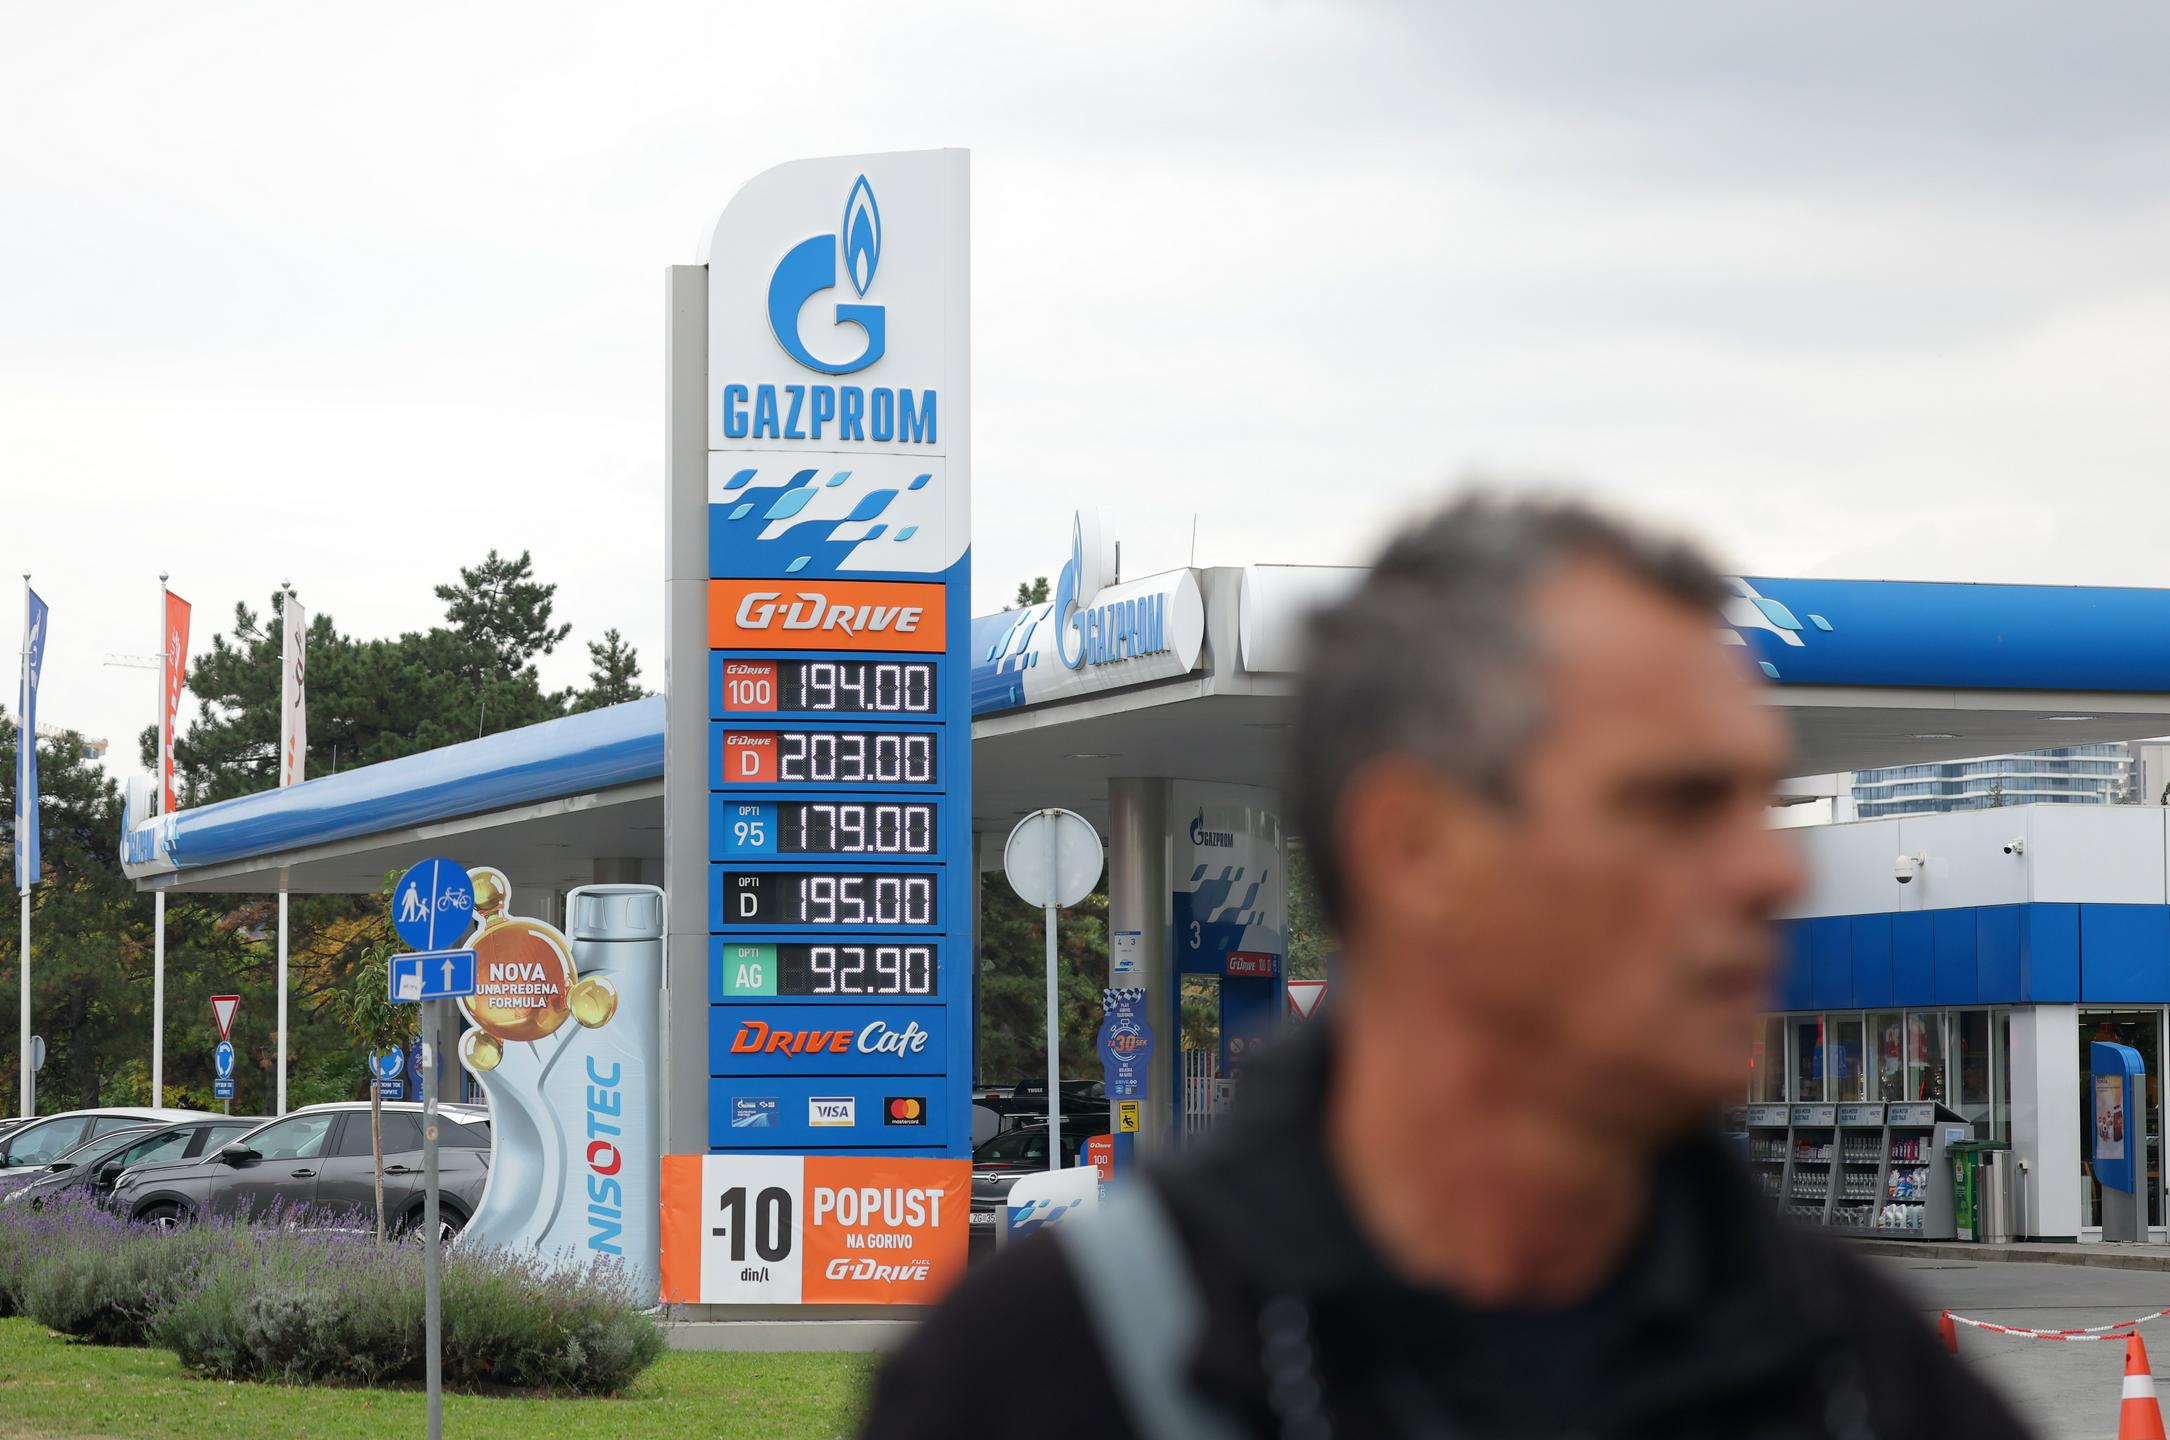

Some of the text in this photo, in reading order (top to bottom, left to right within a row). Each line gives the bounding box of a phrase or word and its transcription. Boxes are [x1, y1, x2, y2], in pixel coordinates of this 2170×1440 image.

[723, 383, 937, 444] GAZPROM
[1086, 592, 1164, 666] GAZPROM
[728, 680, 770, 705] 100
[800, 664, 930, 711] 194.00
[741, 750, 760, 776] D
[781, 734, 930, 781] 203.00
[739, 806, 760, 816] OPTI
[734, 821, 764, 847] 95
[800, 805, 930, 852] 179.00
[1204, 831, 1234, 849] GAZPROM
[738, 877, 759, 887] OPTI
[740, 893, 758, 917] D
[800, 877, 930, 924] 195.00
[1190, 920, 1201, 950] 3
[738, 948, 759, 958] OPTI
[489, 963, 546, 981] NOVA
[735, 964, 762, 988] AG
[810, 947, 930, 993] 92.90
[476, 983, 559, 995] UNAPREĐENA
[489, 997, 547, 1008] FORMULA
[730, 1020, 929, 1058] DRIVE Cafe
[1115, 1034, 1136, 1053] 30
[816, 1105, 849, 1118] VISA
[586, 1055, 622, 1255] NISOTEC
[1094, 1155, 1108, 1164] 100
[813, 1187, 945, 1227] POPUST
[712, 1186, 792, 1263] -10
[846, 1233, 913, 1249] NA GORIVO
[740, 1267, 769, 1283] din/l
